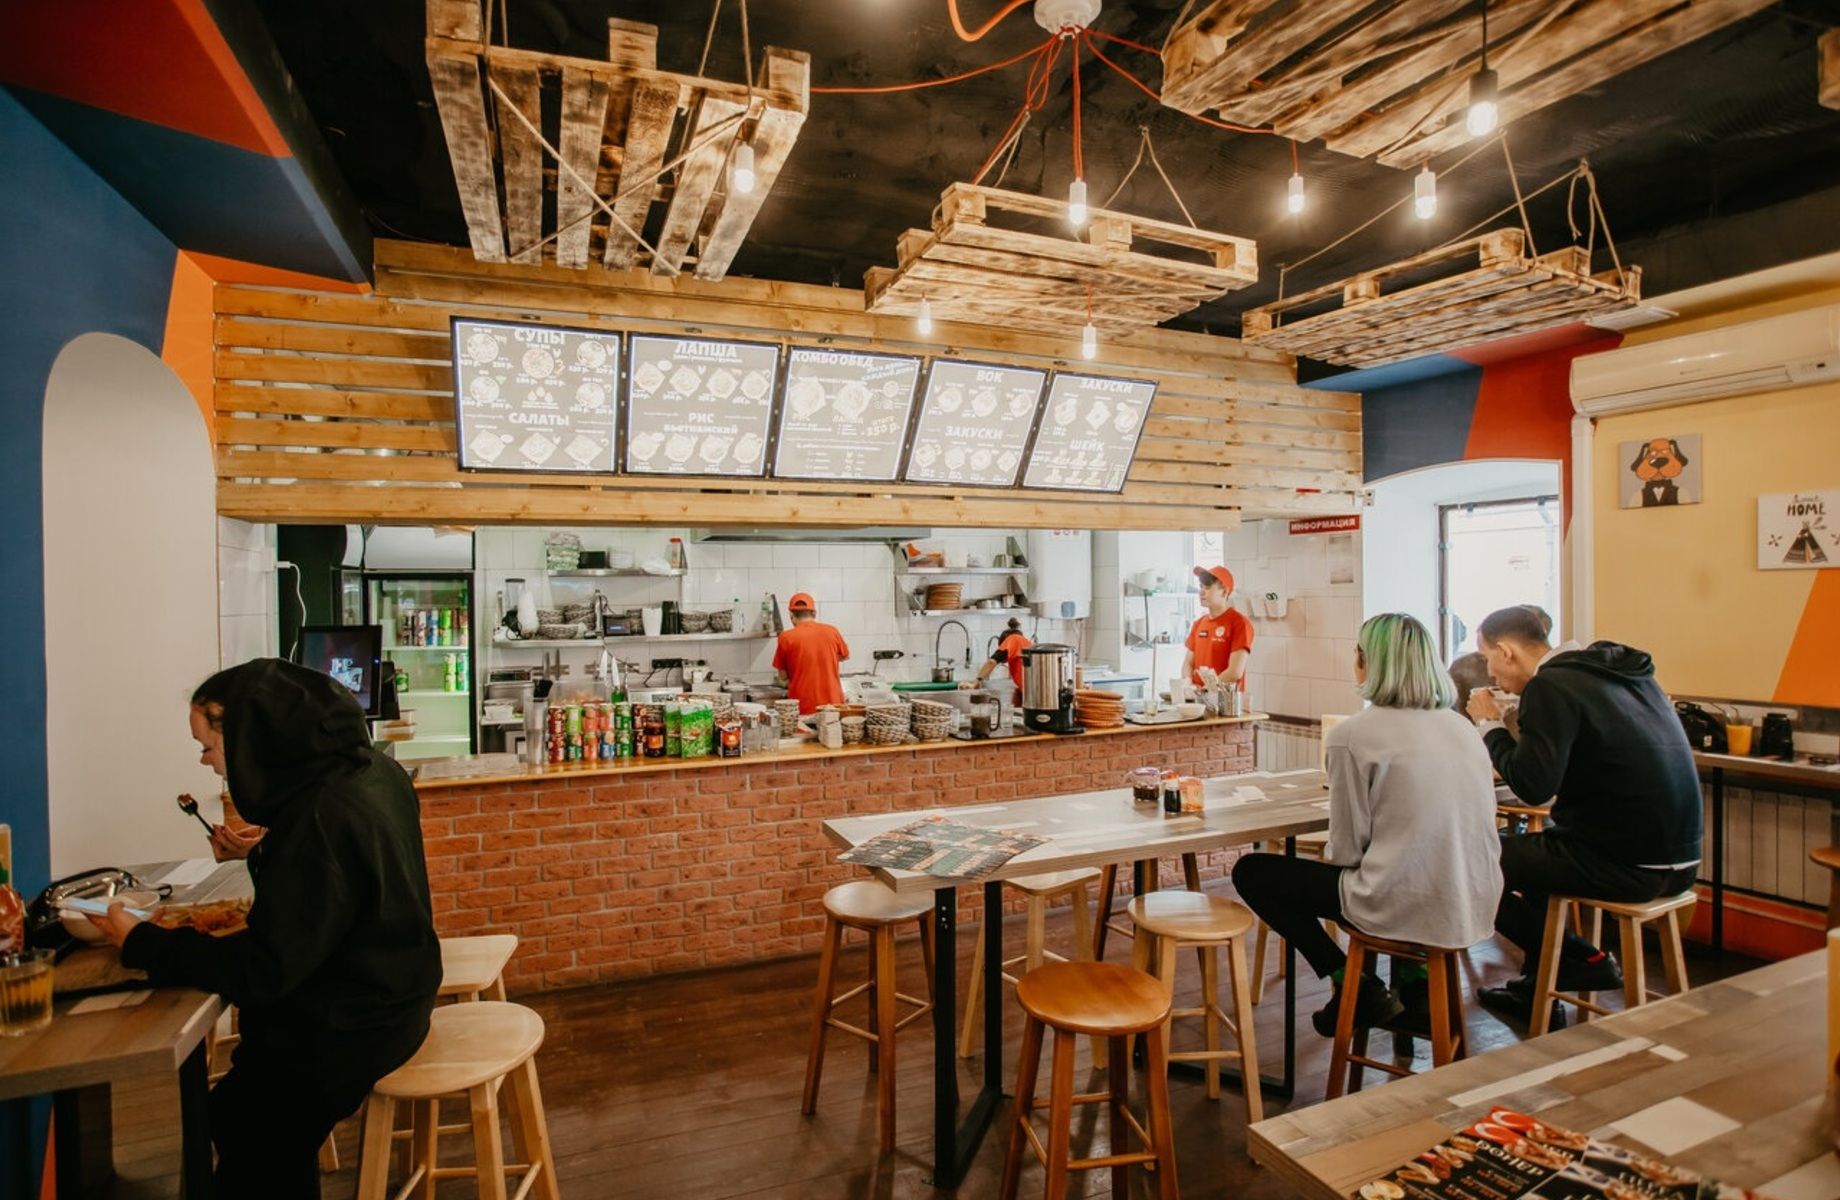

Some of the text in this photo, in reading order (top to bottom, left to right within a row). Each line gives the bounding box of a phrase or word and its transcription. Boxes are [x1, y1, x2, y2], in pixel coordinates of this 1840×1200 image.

[514, 329, 565, 345] СУПЫ
[675, 341, 737, 358] ЛАПША
[976, 369, 1005, 383] ВОК
[1079, 378, 1135, 394] ЗАКУСКИ
[508, 412, 569, 426] САЛАТЫ
[688, 412, 714, 424] РИС
[944, 425, 1004, 440] ЗАКУСКИ
[1069, 438, 1105, 452] ШЕЙК
[1787, 503, 1826, 516] HOME
[1290, 518, 1356, 531] ИНФОРМАЦИЯ
